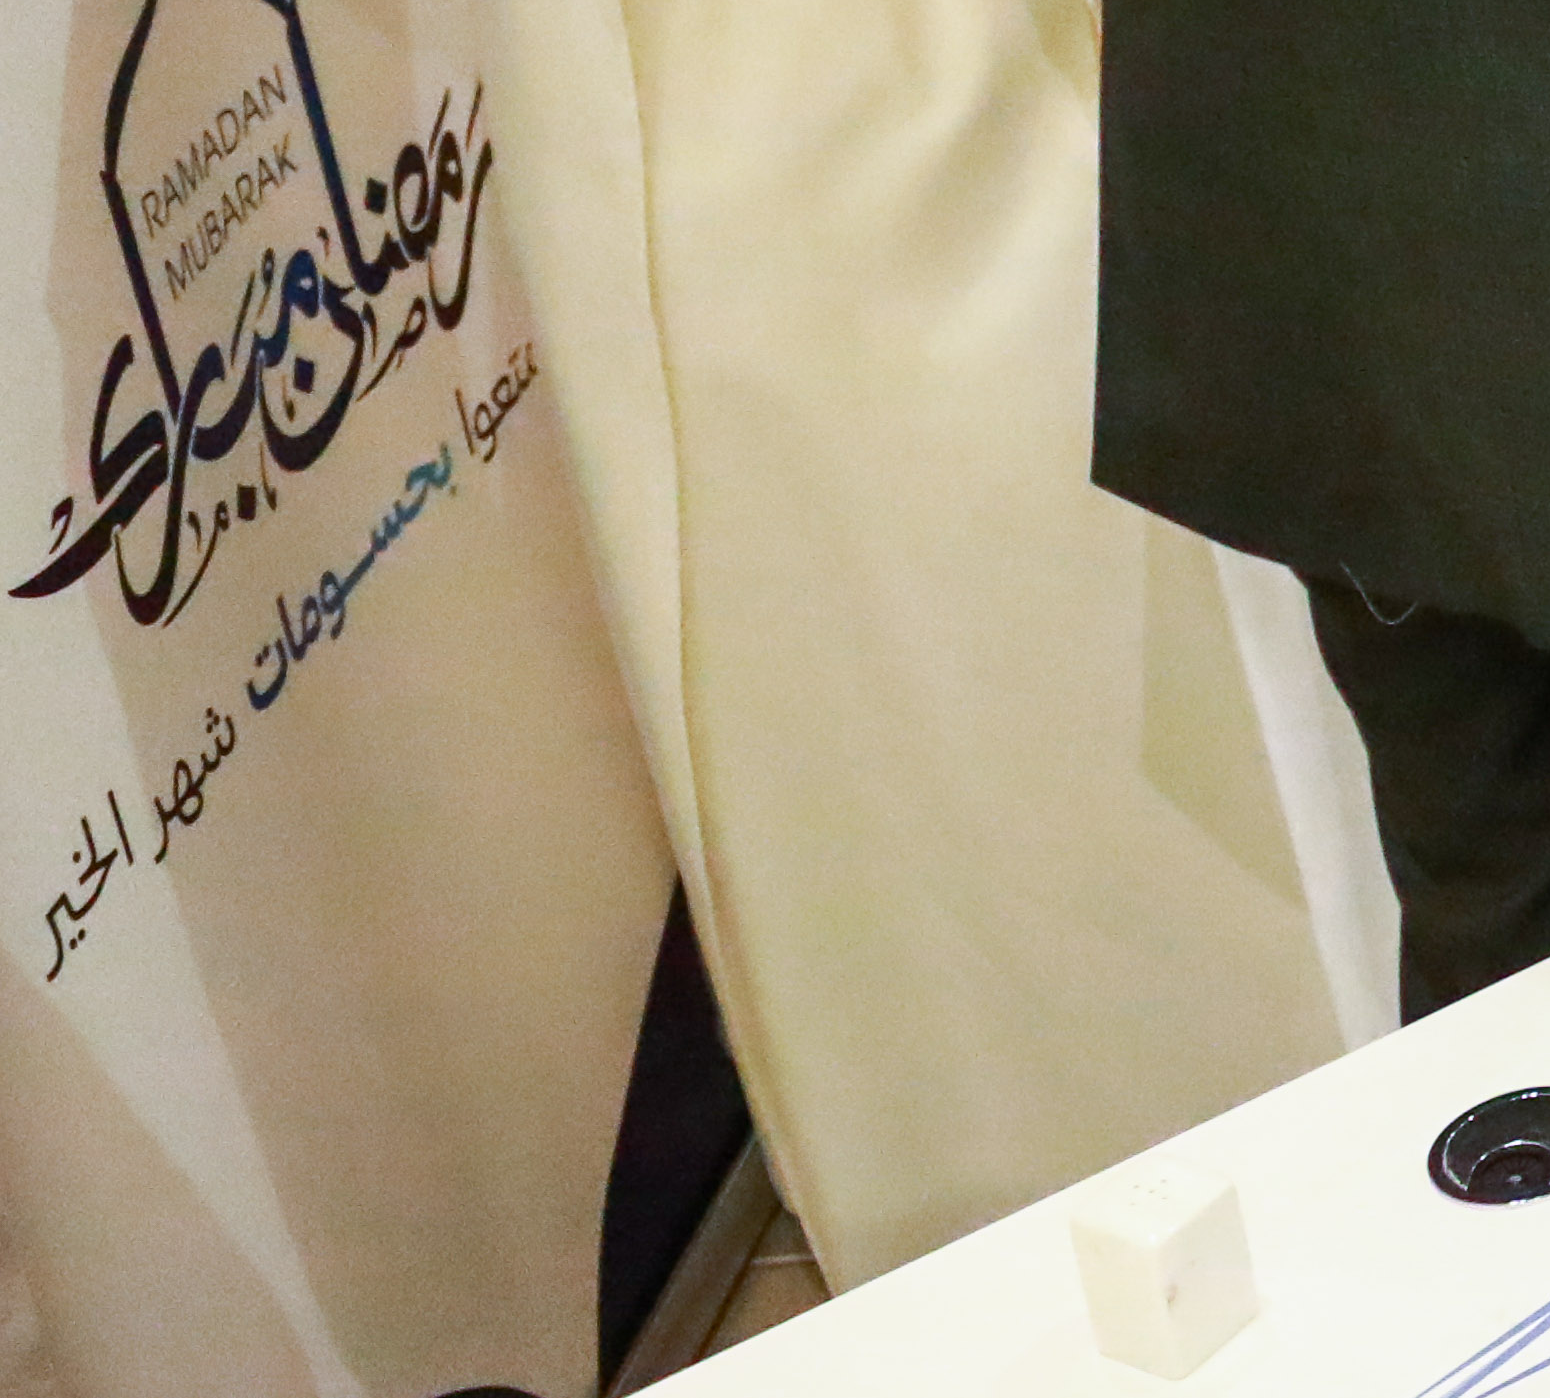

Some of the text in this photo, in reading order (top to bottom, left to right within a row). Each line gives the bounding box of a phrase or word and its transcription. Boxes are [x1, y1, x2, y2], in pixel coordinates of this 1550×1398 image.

[141, 64, 287, 239] RAMADAN
[164, 132, 297, 302] MUBARAK
[245, 441, 457, 710] بحسومات
[154, 706, 236, 865] شهر
[46, 789, 134, 983] الخير
